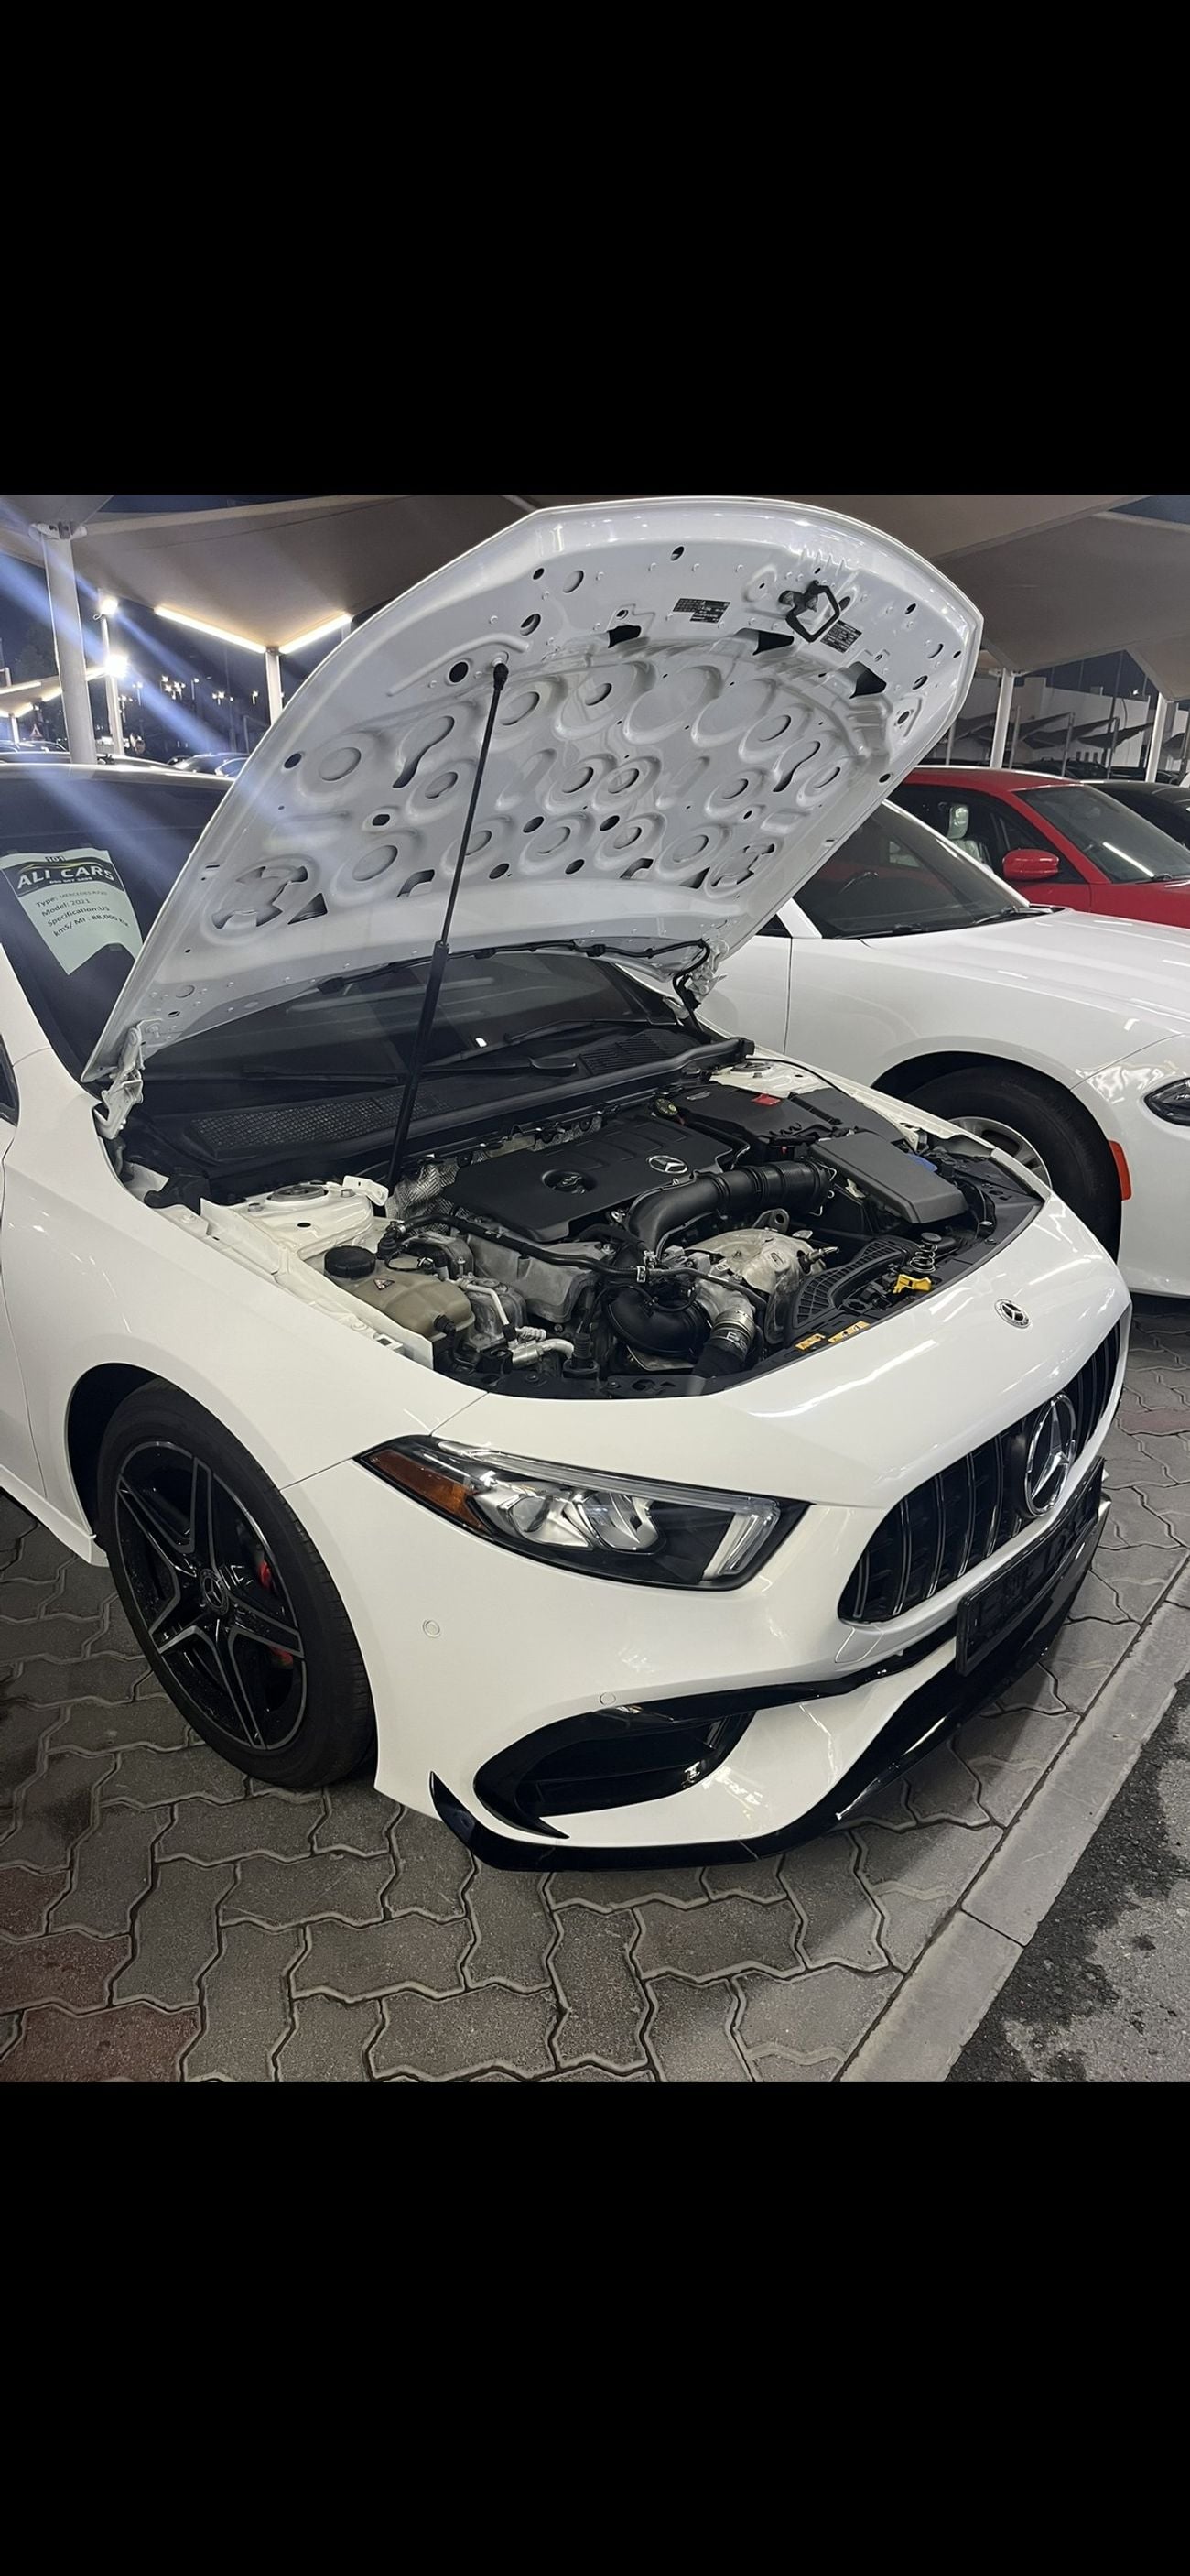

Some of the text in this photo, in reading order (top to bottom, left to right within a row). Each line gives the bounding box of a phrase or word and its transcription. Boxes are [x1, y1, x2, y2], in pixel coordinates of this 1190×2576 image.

[16, 865, 115, 890] ALI CARS
[37, 897, 58, 908] Type:
[41, 898, 91, 917] Model: 2021
